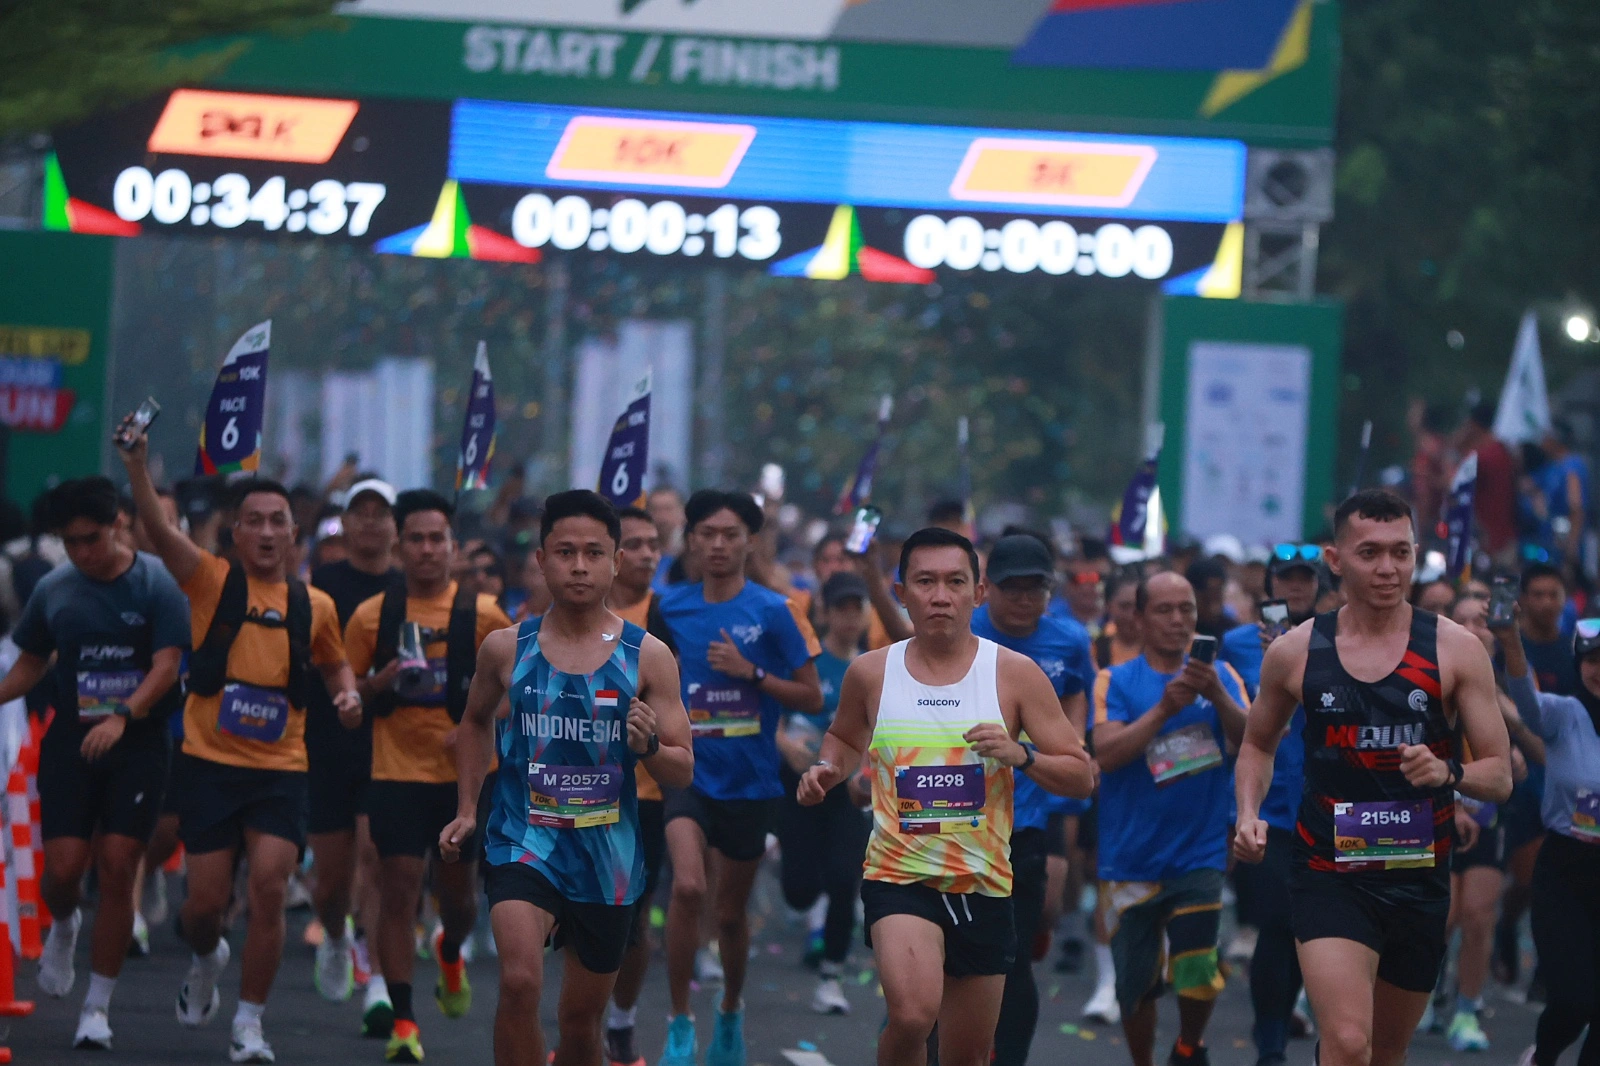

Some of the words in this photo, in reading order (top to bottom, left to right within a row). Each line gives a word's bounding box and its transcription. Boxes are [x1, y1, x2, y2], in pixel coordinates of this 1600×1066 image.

[463, 26, 626, 79] START
[630, 36, 663, 82] /
[669, 40, 841, 91] FINISH
[113, 165, 387, 236] 00:34:37
[511, 193, 782, 260] 00:00:13
[904, 214, 1174, 280] 00:00:00
[239, 366, 261, 380] 10K
[220, 396, 246, 413] PACE
[221, 416, 239, 450] 6
[465, 432, 478, 466] 6
[611, 461, 629, 496] 6
[231, 699, 279, 720] PACER
[917, 698, 961, 707] saucony
[521, 713, 620, 742] INDONESIA
[543, 774, 557, 786] M
[561, 774, 610, 786] 20573
[917, 774, 964, 788] 21298
[535, 795, 551, 805] 10K
[900, 801, 915, 810] 10K
[1361, 810, 1411, 825] 21548
[1340, 840, 1360, 848] 10K
